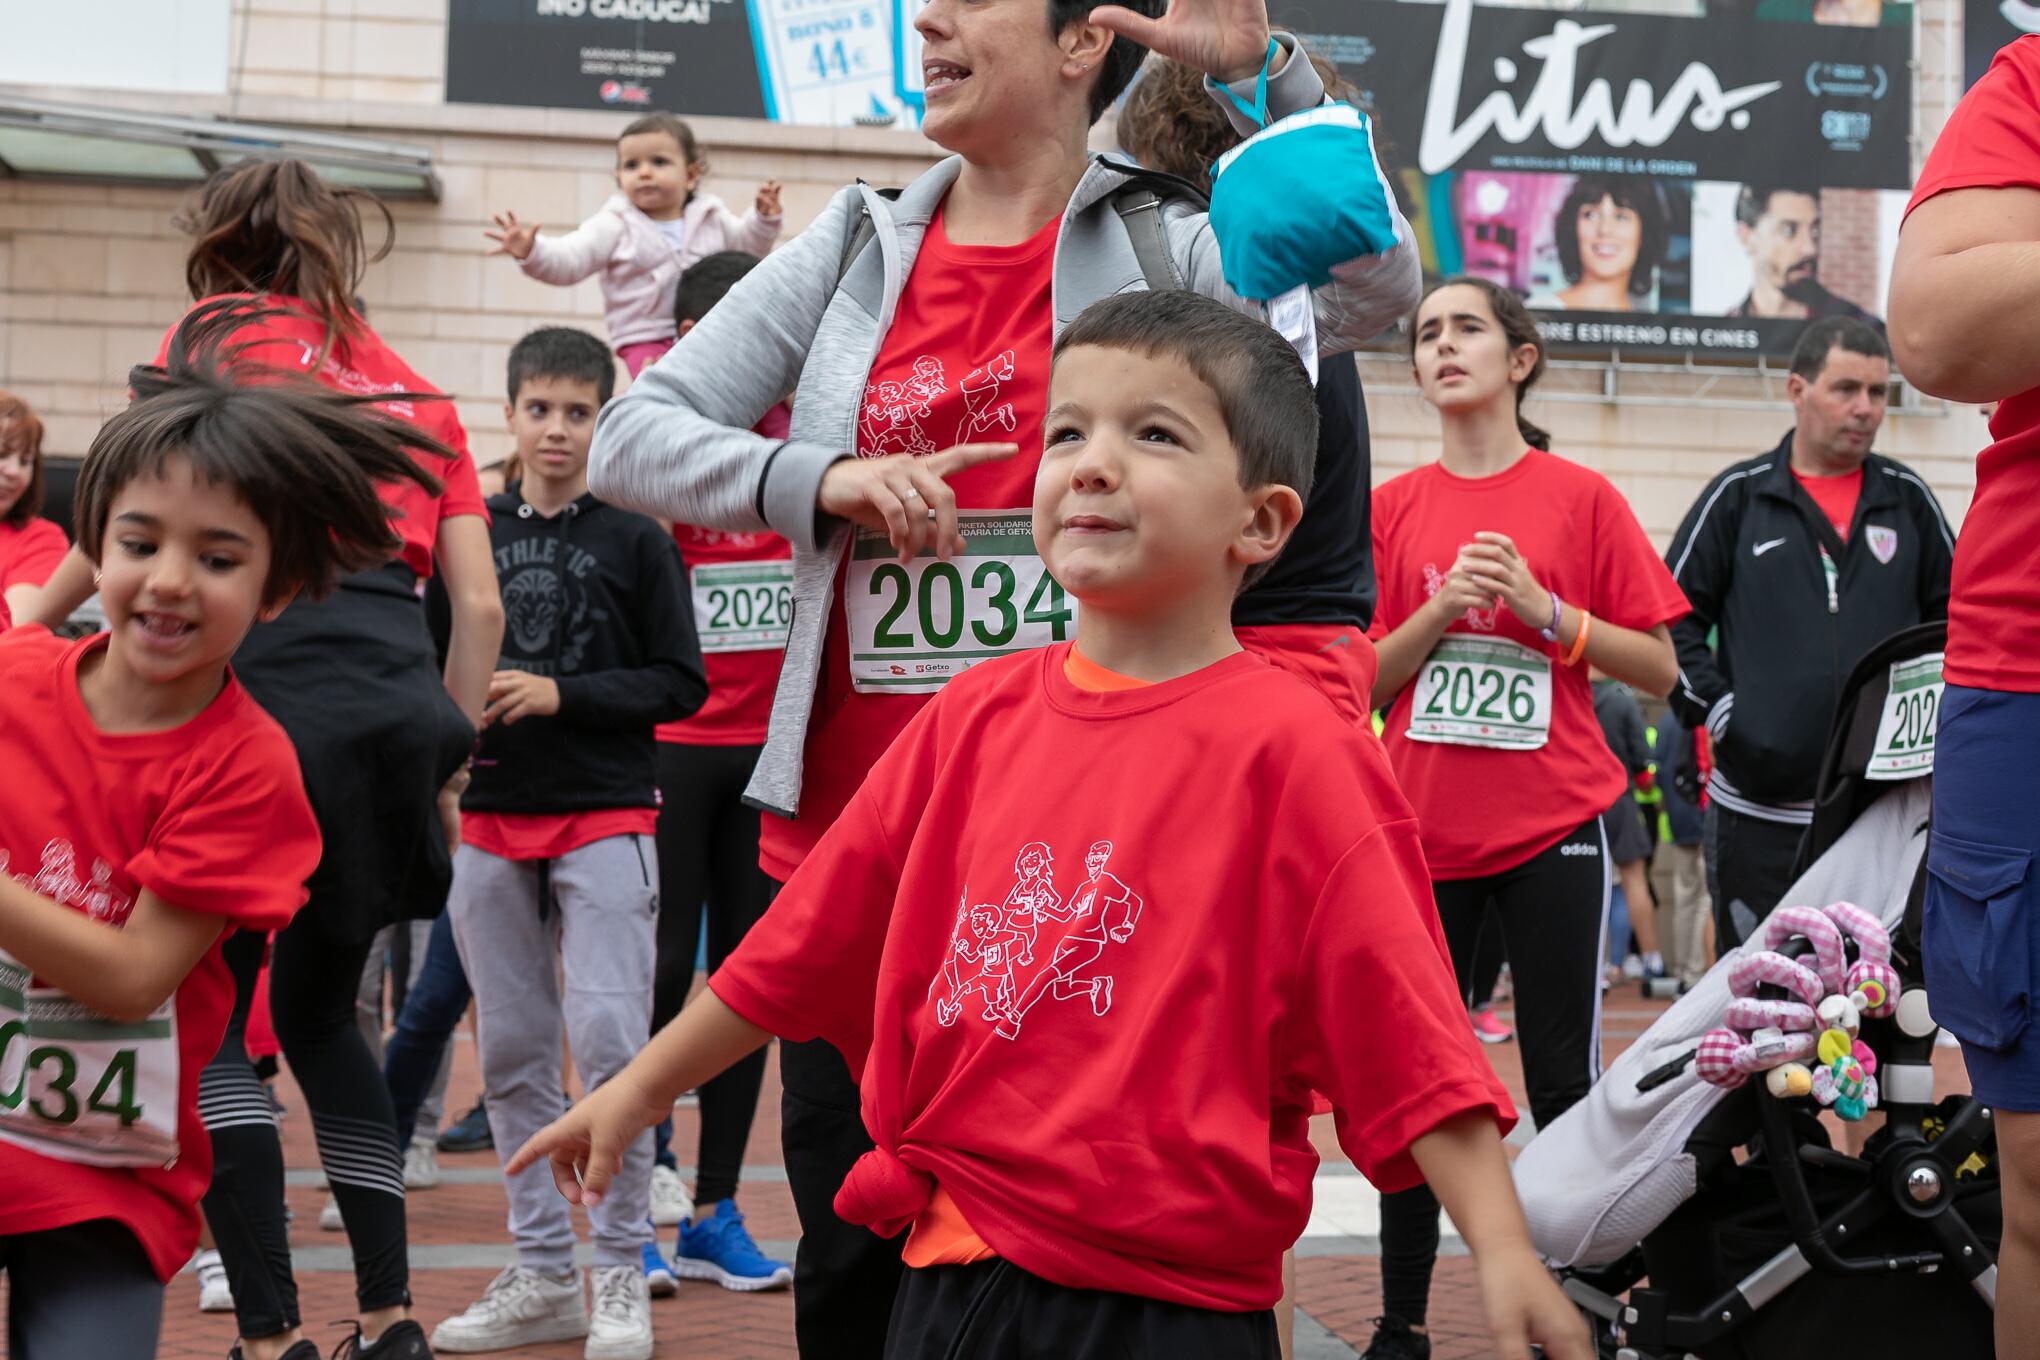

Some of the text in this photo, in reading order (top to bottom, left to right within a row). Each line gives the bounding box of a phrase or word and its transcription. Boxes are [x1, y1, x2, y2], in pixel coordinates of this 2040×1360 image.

[787, 18, 853, 41] BONO
[1567, 154, 1602, 171] DANI
[1604, 156, 1625, 173] DE
[1626, 158, 1646, 173] LA
[1647, 158, 1698, 176] ORDEN
[1577, 322, 1667, 345] ESTRENO
[1669, 326, 1698, 346] EN
[1701, 327, 1759, 348] CINES
[959, 527, 1034, 537] IDARIA DE GETX
[495, 536, 598, 579] THLEIC
[708, 586, 792, 629] 2026
[869, 560, 1073, 649] 2034
[925, 663, 950, 672] Getxo
[1424, 664, 1536, 724] 2026
[1888, 689, 1937, 750] 202
[1560, 842, 1599, 857] adidas
